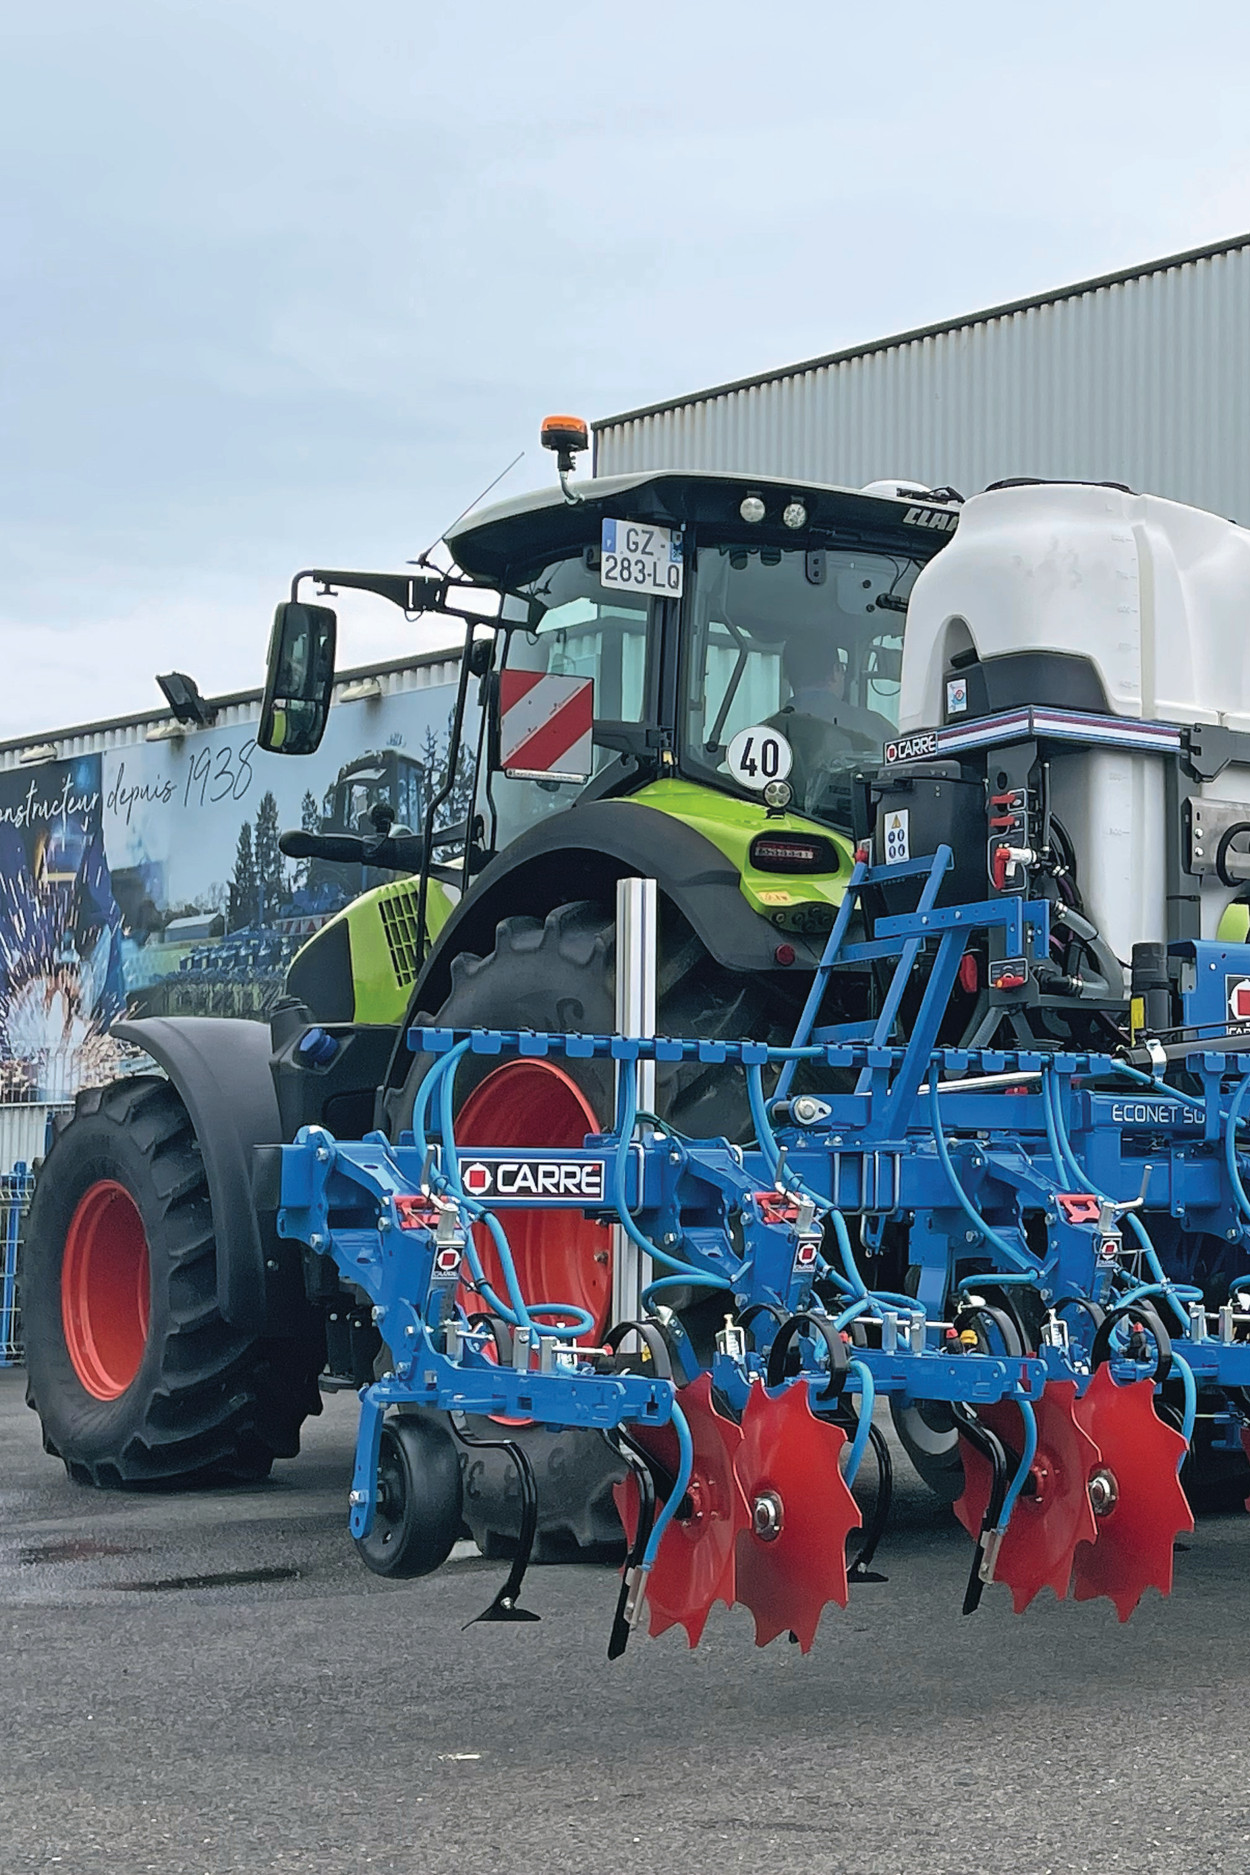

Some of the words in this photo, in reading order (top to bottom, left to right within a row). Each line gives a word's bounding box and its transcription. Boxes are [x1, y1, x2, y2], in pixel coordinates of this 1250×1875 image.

[605, 555, 680, 590] 283-LQ
[740, 737, 779, 777] 40
[106, 762, 177, 825] depuis
[184, 738, 258, 807] 1938
[1112, 1104, 1178, 1123] ECONET
